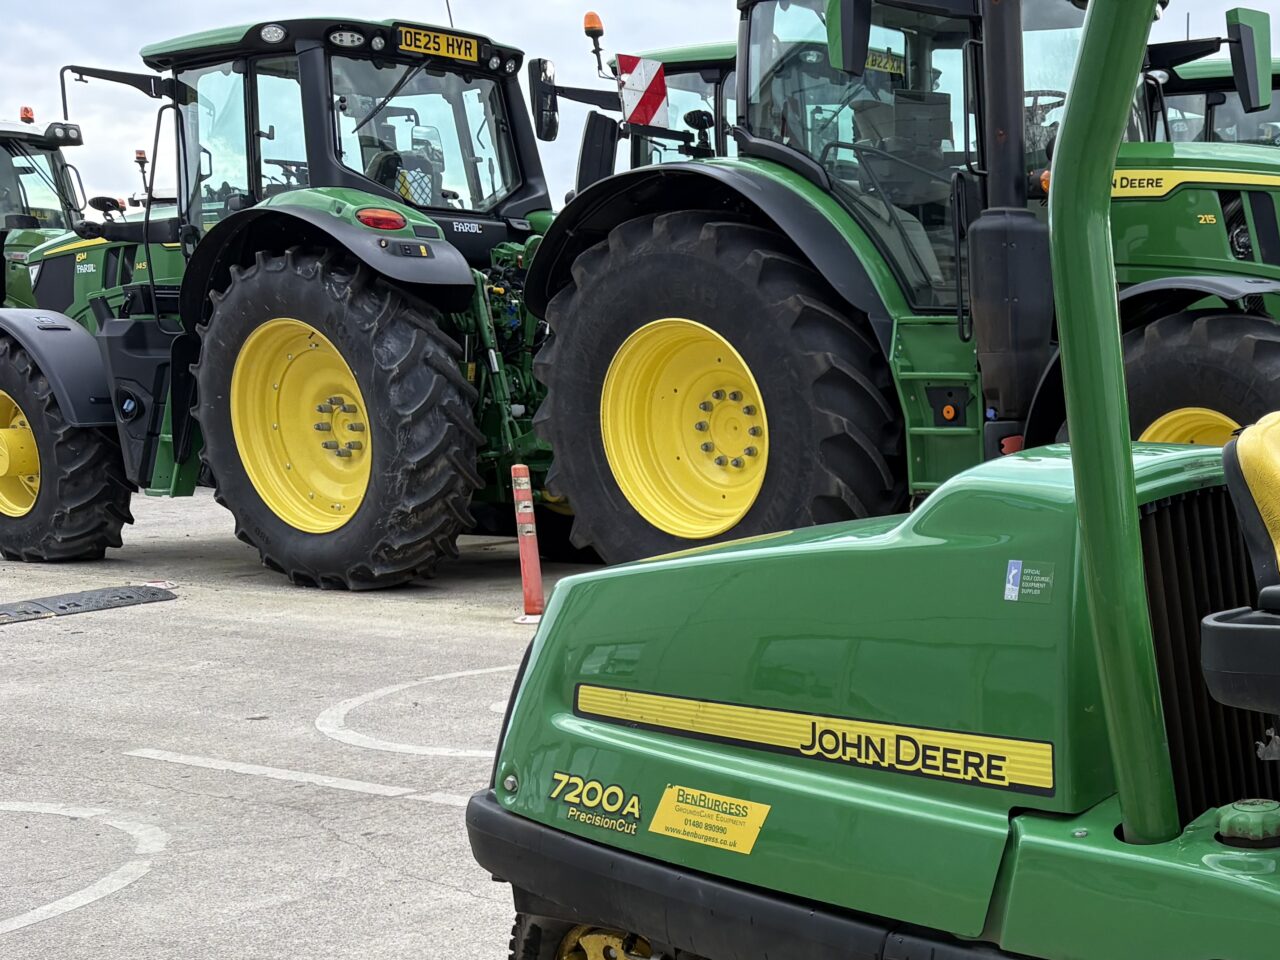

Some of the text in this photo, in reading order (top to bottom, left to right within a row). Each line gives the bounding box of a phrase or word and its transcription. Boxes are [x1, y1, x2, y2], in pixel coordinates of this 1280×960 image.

[404, 30, 473, 57] OE25 HYR
[1120, 176, 1163, 189] DEERE
[452, 221, 482, 234] FAROL
[1197, 214, 1217, 224] 215
[800, 721, 1008, 783] JOHN DEERE
[551, 772, 640, 818] 7200A
[567, 806, 638, 836] PrecisionCut
[684, 818, 704, 830] 01480
[664, 824, 738, 848] www.benburgess.co.uk
